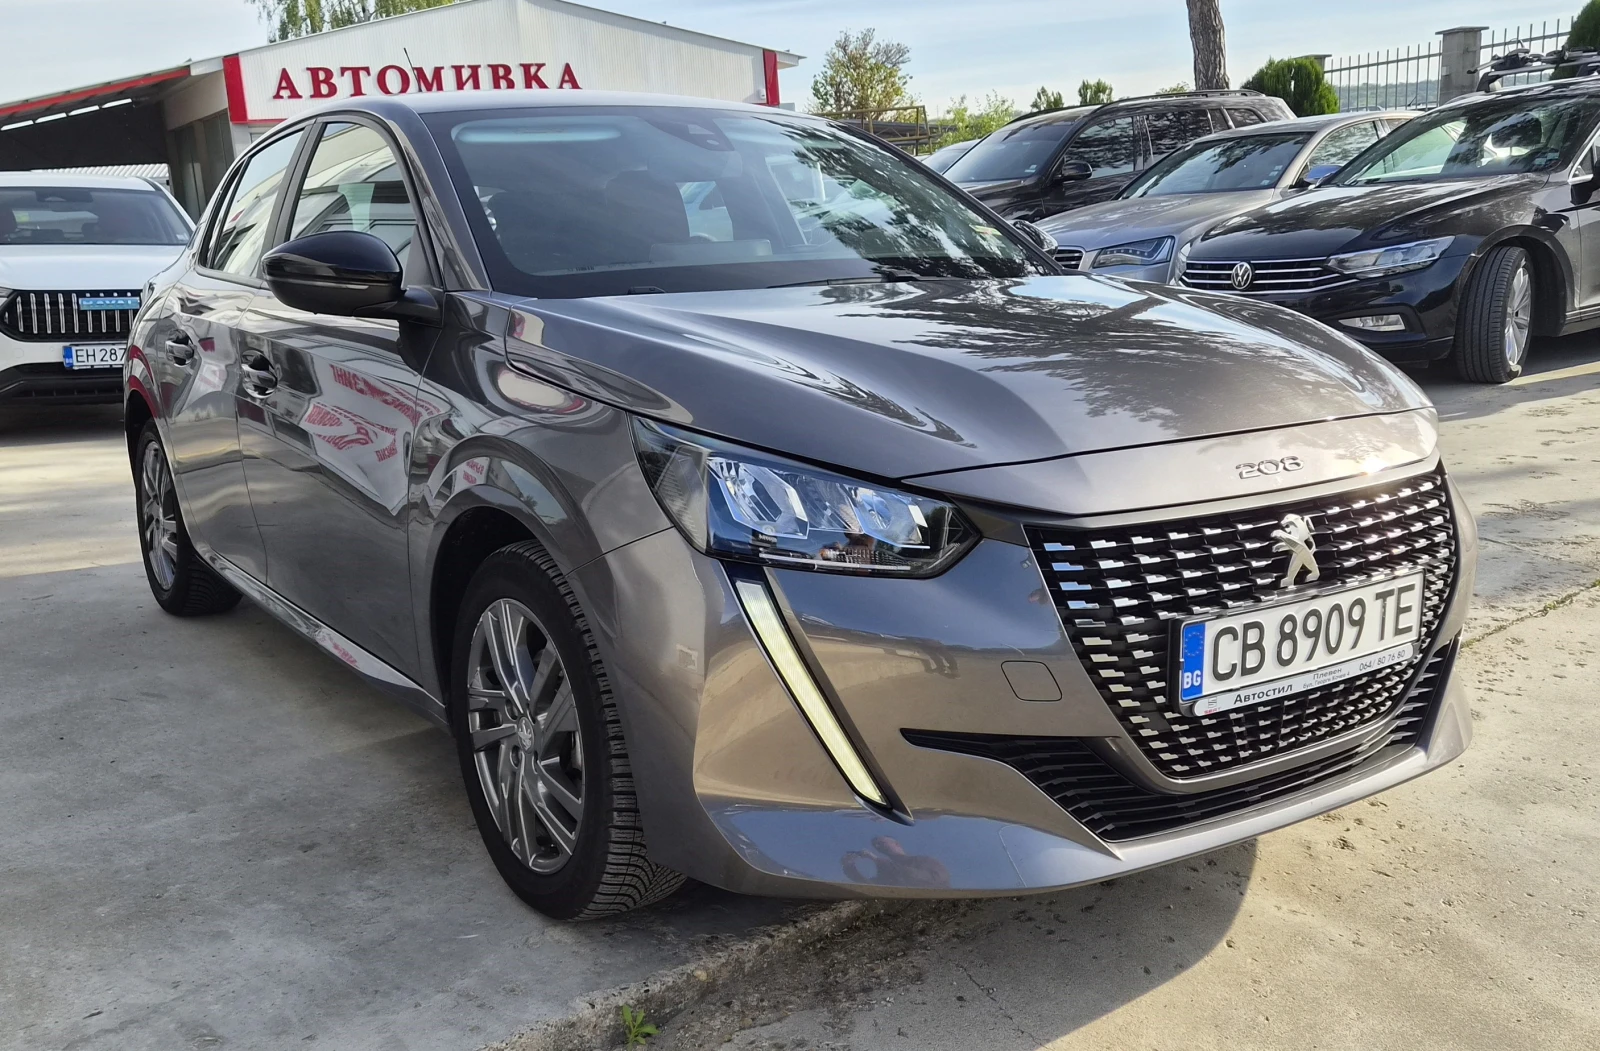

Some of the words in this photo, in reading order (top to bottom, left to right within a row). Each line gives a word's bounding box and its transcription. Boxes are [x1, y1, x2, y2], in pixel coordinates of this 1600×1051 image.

[272, 62, 583, 100] АВТОМИВКА
[75, 348, 96, 363] EH
[1212, 620, 1266, 682] CB
[1276, 597, 1367, 667] 8909
[1375, 583, 1416, 641] TE
[1183, 670, 1202, 689] BG
